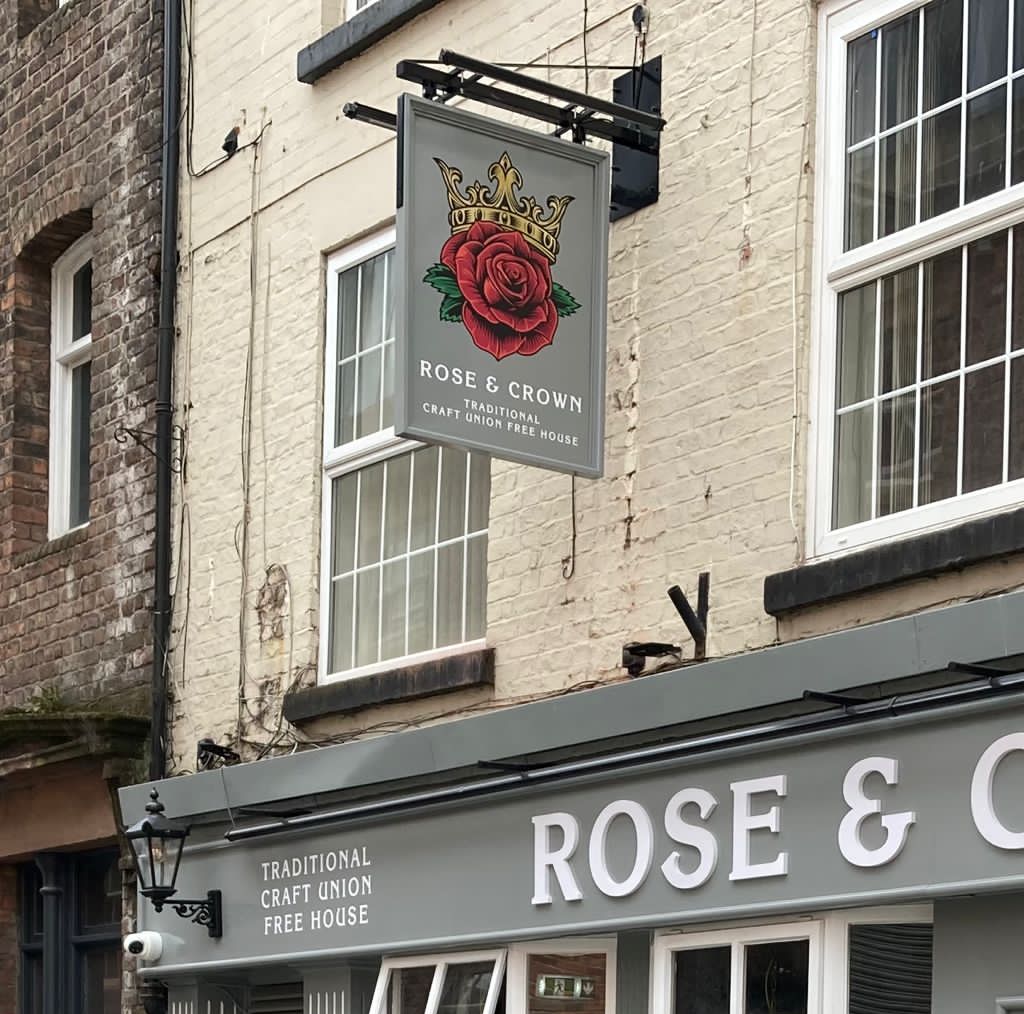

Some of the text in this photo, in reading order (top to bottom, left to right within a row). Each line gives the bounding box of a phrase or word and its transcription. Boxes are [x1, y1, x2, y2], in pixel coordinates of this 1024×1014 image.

[420, 360, 583, 414] ROSE & CROWN
[422, 402, 579, 447] CRAFT UNION FREE HOUSE
[463, 399, 541, 425] TRADITIONAL
[531, 773, 788, 905] ROSE
[837, 756, 916, 867] &
[261, 846, 371, 881] TRADITIONAL
[260, 874, 372, 909] CRAFT UNION
[263, 904, 369, 936] FREE HOUSE
